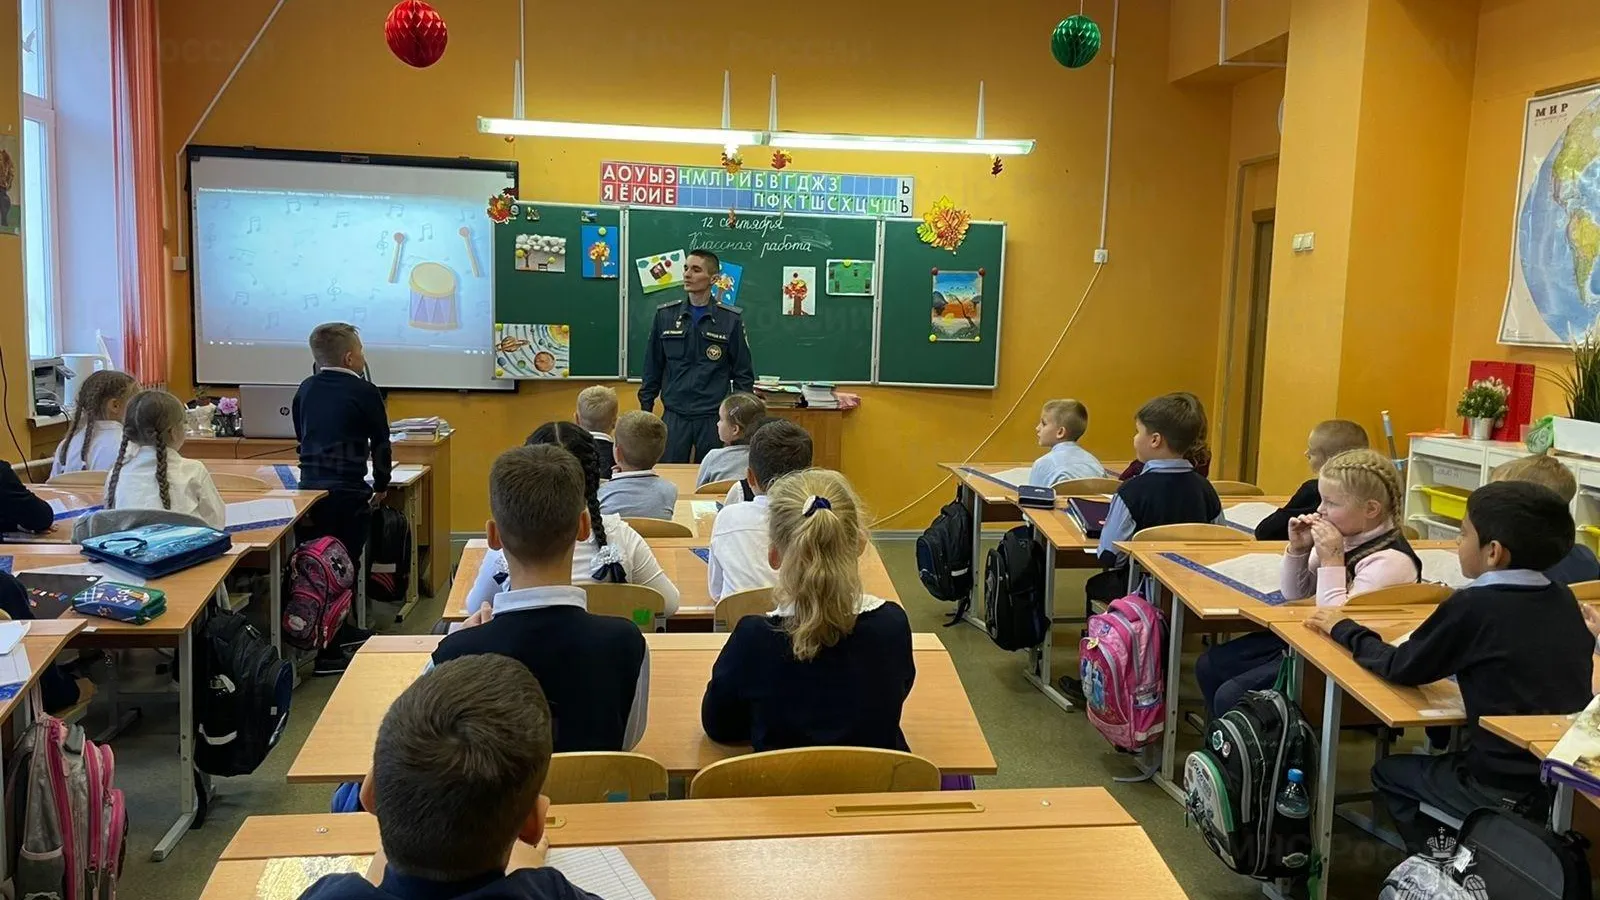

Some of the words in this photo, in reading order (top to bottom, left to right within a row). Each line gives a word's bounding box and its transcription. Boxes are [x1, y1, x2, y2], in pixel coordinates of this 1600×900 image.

[1535, 103, 1568, 117] МИР
[702, 216, 713, 229] 12
[760, 234, 812, 258] работа
